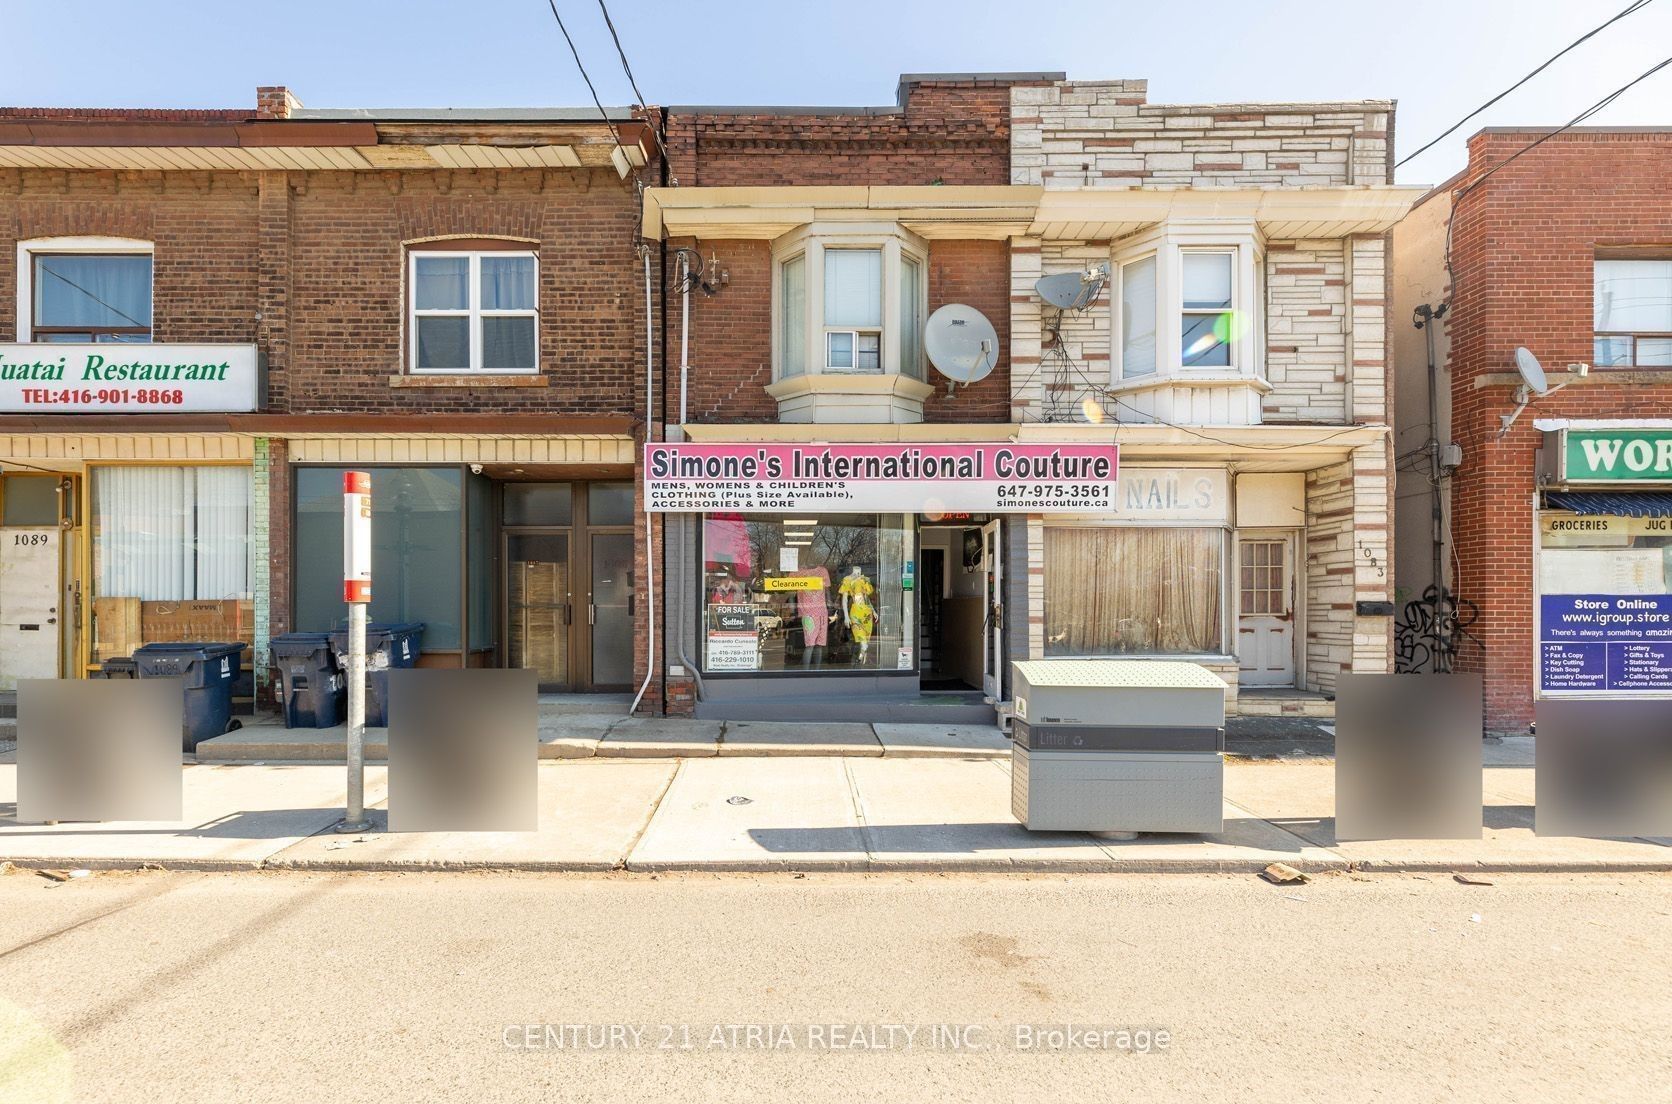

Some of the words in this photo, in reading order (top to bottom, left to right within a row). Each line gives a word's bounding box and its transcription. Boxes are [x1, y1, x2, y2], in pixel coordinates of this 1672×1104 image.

[0, 354, 66, 381] uatai
[81, 354, 230, 381] Restaurant
[22, 388, 183, 405] TEL:416-901-8868
[1580, 439, 1672, 472] WOR
[651, 448, 783, 479] Simone's
[792, 448, 984, 479] International
[994, 448, 1111, 479] Couture
[651, 482, 691, 490] MENS,
[769, 481, 846, 489] CHILDREN'S
[997, 485, 1110, 498] 647-975-3561
[651, 491, 716, 499] CLOTHING
[721, 491, 752, 500] (Plus
[757, 491, 781, 499] Size
[787, 491, 853, 500] Available),
[1125, 479, 1213, 510] NAILS
[651, 500, 740, 508] ACCESSORIES
[745, 500, 754, 508] &
[759, 500, 795, 508] MORE
[996, 499, 1109, 507] simonescouture.ca
[1551, 520, 1608, 531] GROCERIES
[1645, 520, 1666, 530] JUG
[14, 534, 48, 546] 1089
[771, 580, 809, 588] Clearance
[1574, 599, 1609, 609] Store
[1616, 599, 1658, 609] Online
[1562, 612, 1670, 626] www.igroup.store
[1580, 629, 1603, 637] always
[1607, 629, 1642, 637] something
[1040, 731, 1068, 745] Litter
